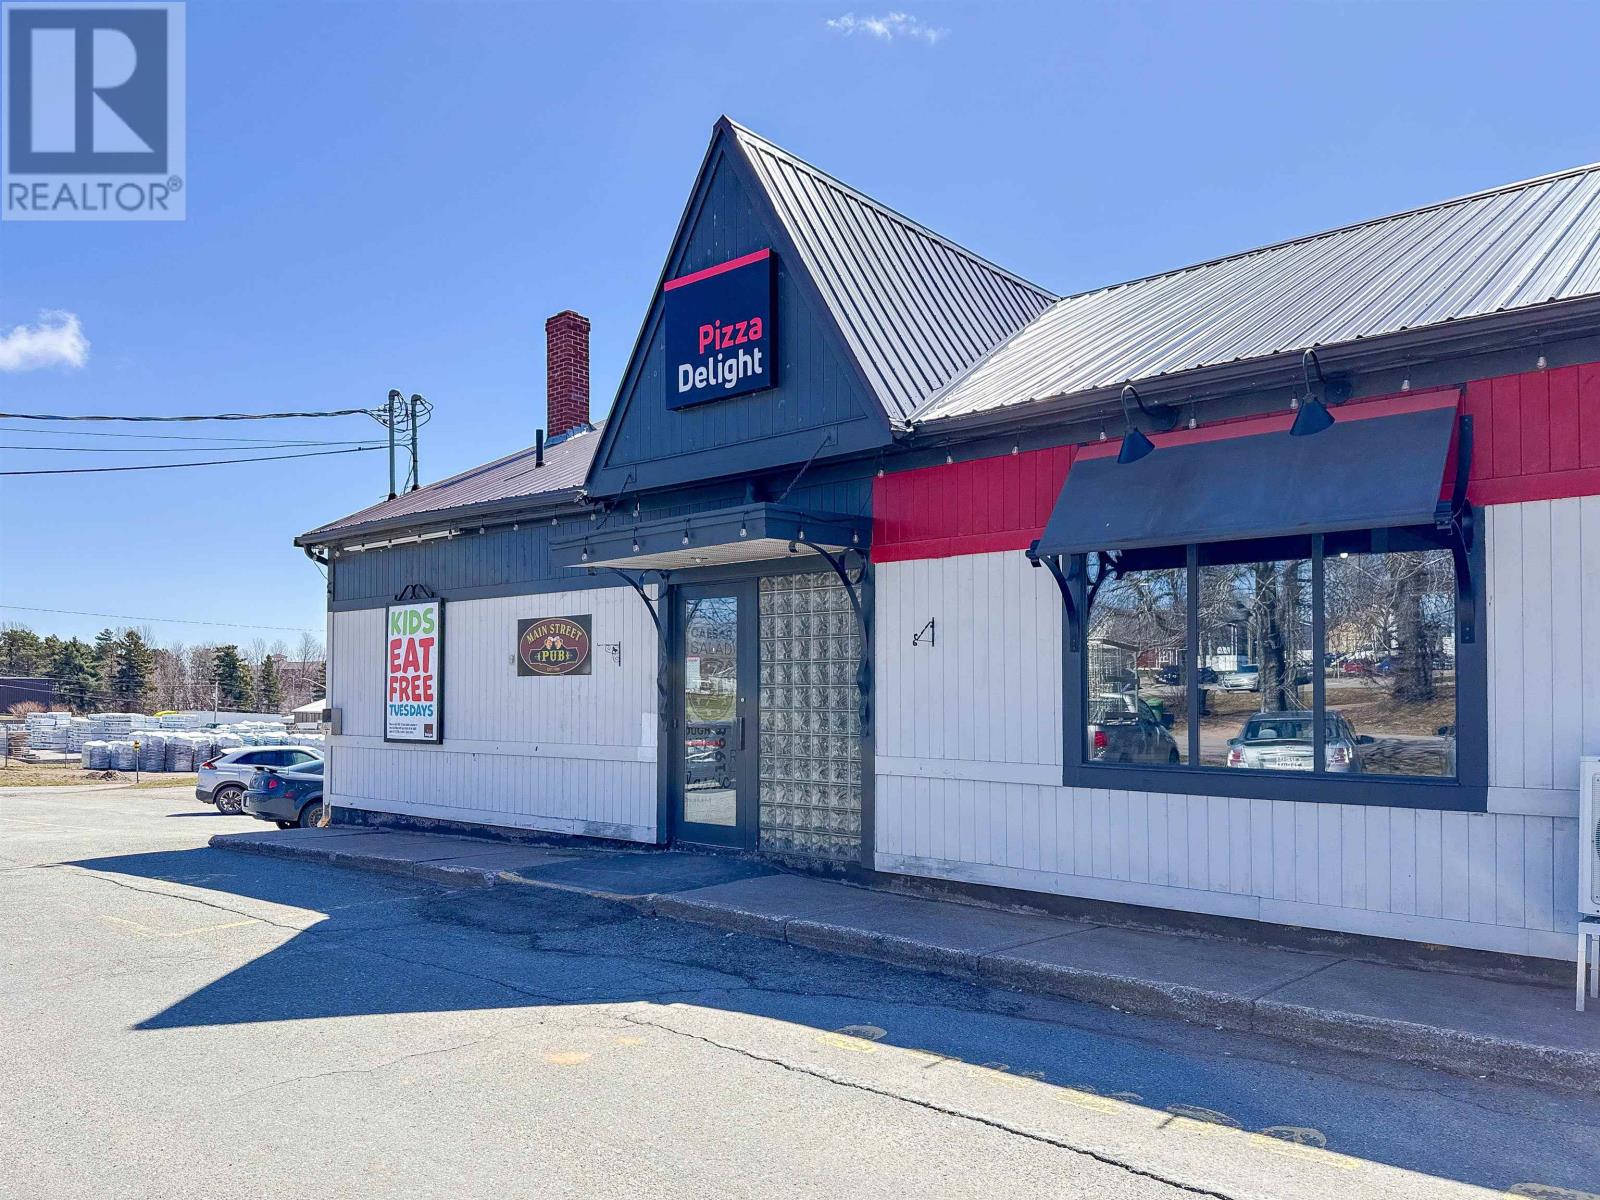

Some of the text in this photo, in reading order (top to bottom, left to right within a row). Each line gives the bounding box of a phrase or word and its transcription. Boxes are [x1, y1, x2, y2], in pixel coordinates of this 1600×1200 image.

[698, 316, 763, 355] Pizza
[678, 347, 763, 393] Delight
[390, 607, 435, 636] KIDS
[526, 623, 583, 645] MAIN STREET
[389, 637, 435, 674] EAT
[541, 649, 566, 662] PUB
[389, 674, 434, 703] FREE
[388, 703, 434, 718] TUESDAYS
